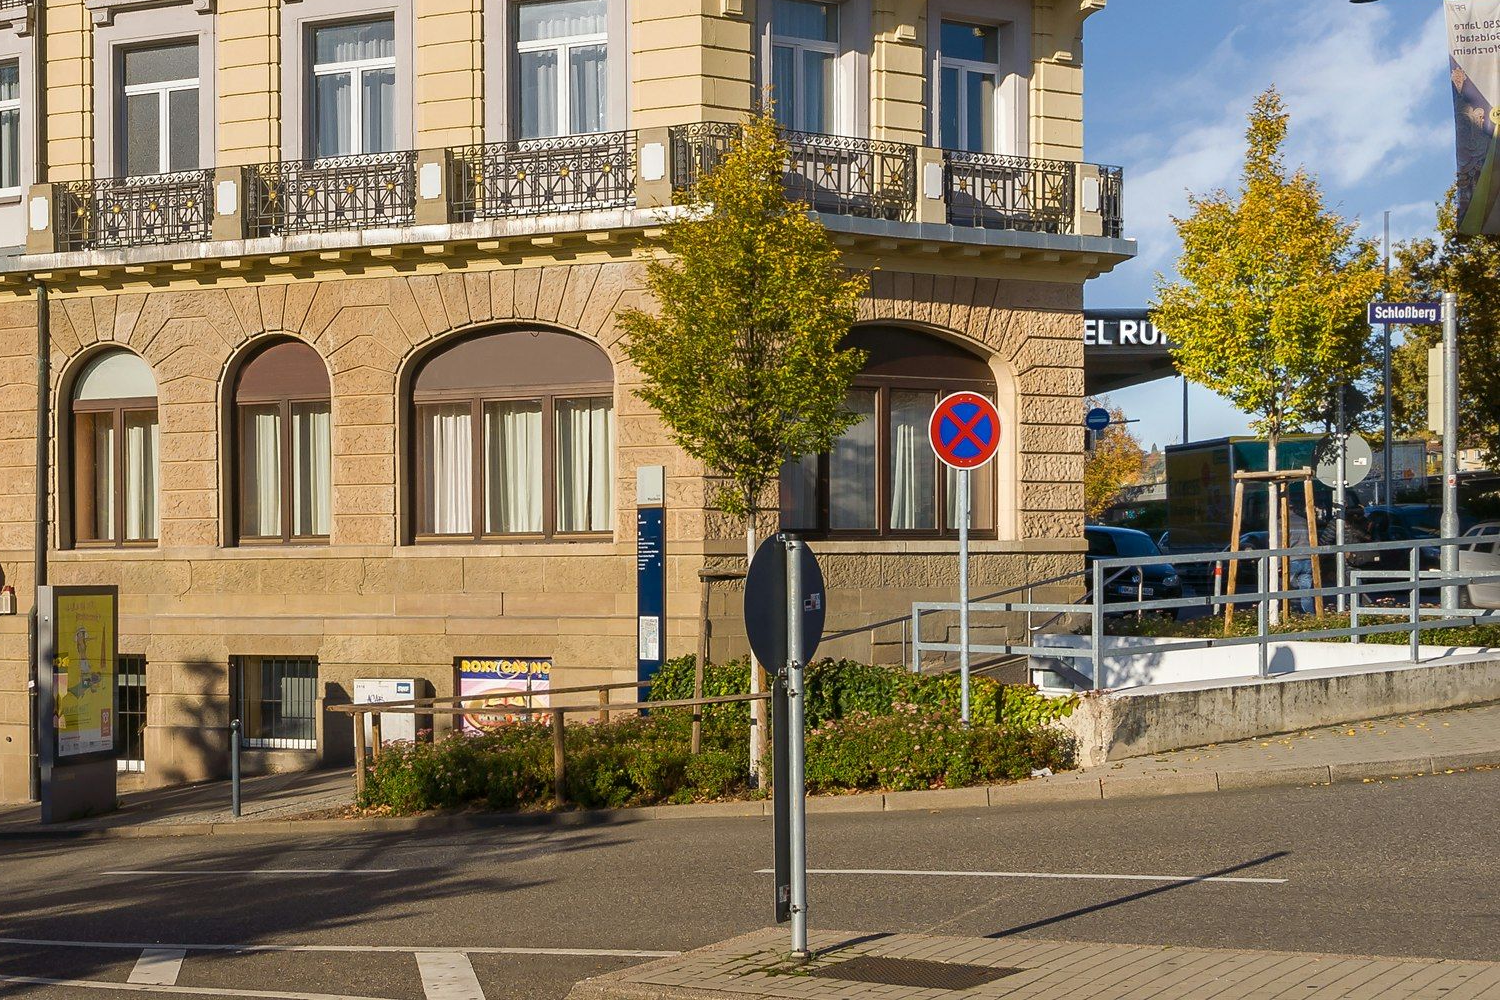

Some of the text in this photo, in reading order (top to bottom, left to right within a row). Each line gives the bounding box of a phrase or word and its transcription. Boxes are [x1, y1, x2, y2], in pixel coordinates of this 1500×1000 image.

[1375, 305, 1436, 322] Schloßberg
[461, 659, 551, 674] ROXY CASNO
